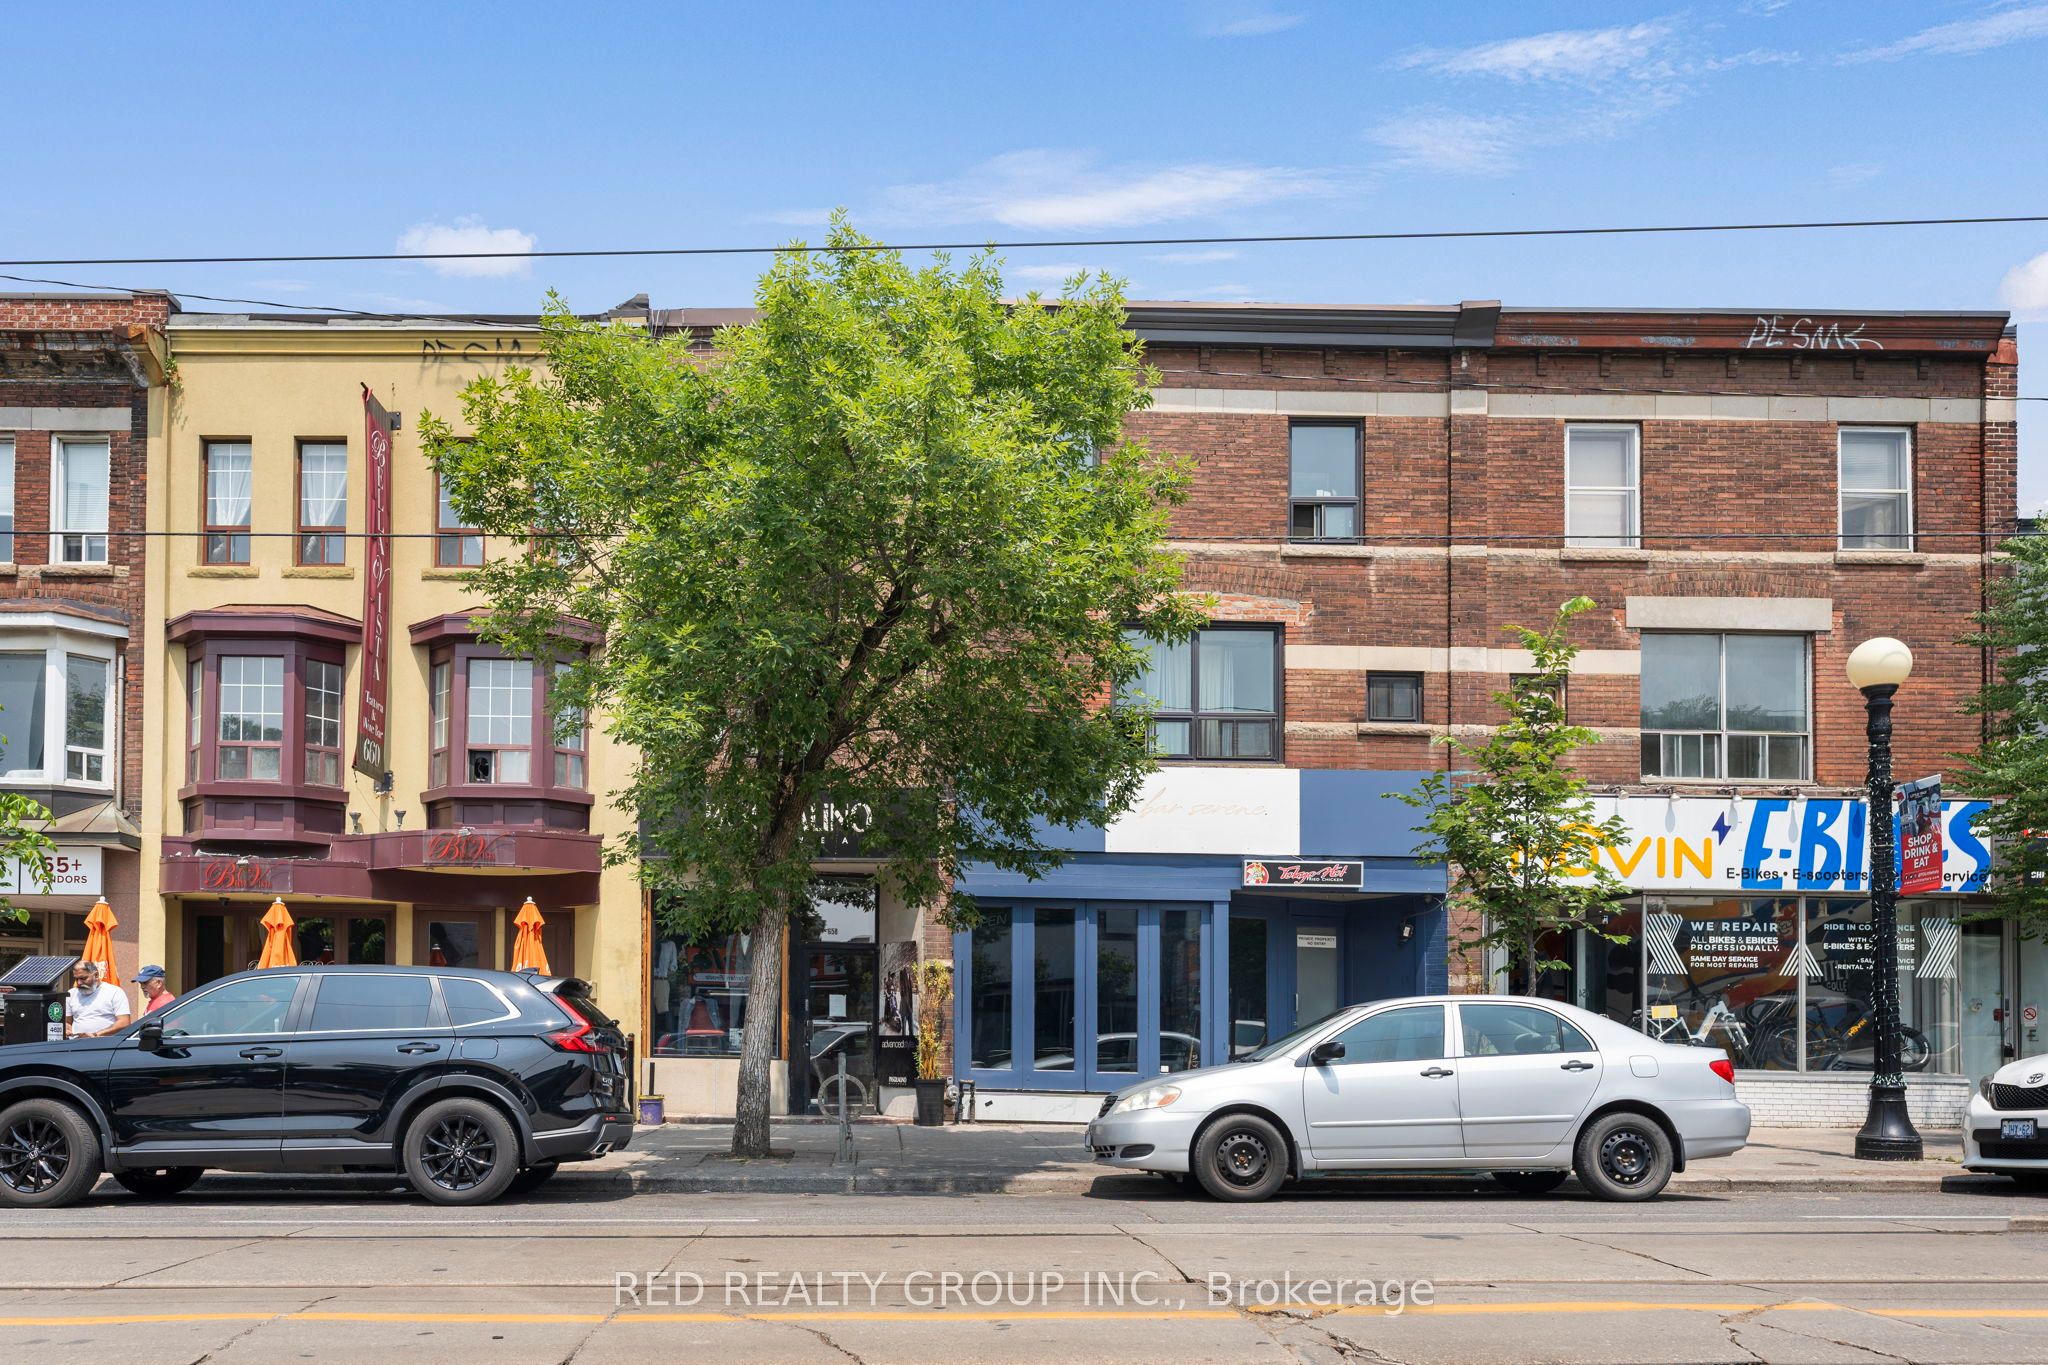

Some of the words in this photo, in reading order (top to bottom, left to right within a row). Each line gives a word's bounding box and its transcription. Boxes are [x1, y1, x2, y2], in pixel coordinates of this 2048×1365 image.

[363, 739, 381, 767] 660
[1904, 847, 1931, 860] DRINK
[1932, 842, 1939, 853] &
[1913, 856, 1930, 869] EAT
[1726, 867, 1780, 881] E-Bikes
[1792, 867, 1869, 882] E-scooters
[1943, 867, 1988, 883] ervice
[1690, 921, 1715, 932] WE
[1721, 922, 1779, 932] REPAIR
[1823, 923, 1845, 931] RIDE
[1690, 936, 1708, 944] ALL
[1708, 936, 1736, 944] BIKES
[1737, 936, 1745, 944] &
[1745, 936, 1779, 945] EBIKES
[1690, 944, 1780, 952] PROFESSIONALLY.
